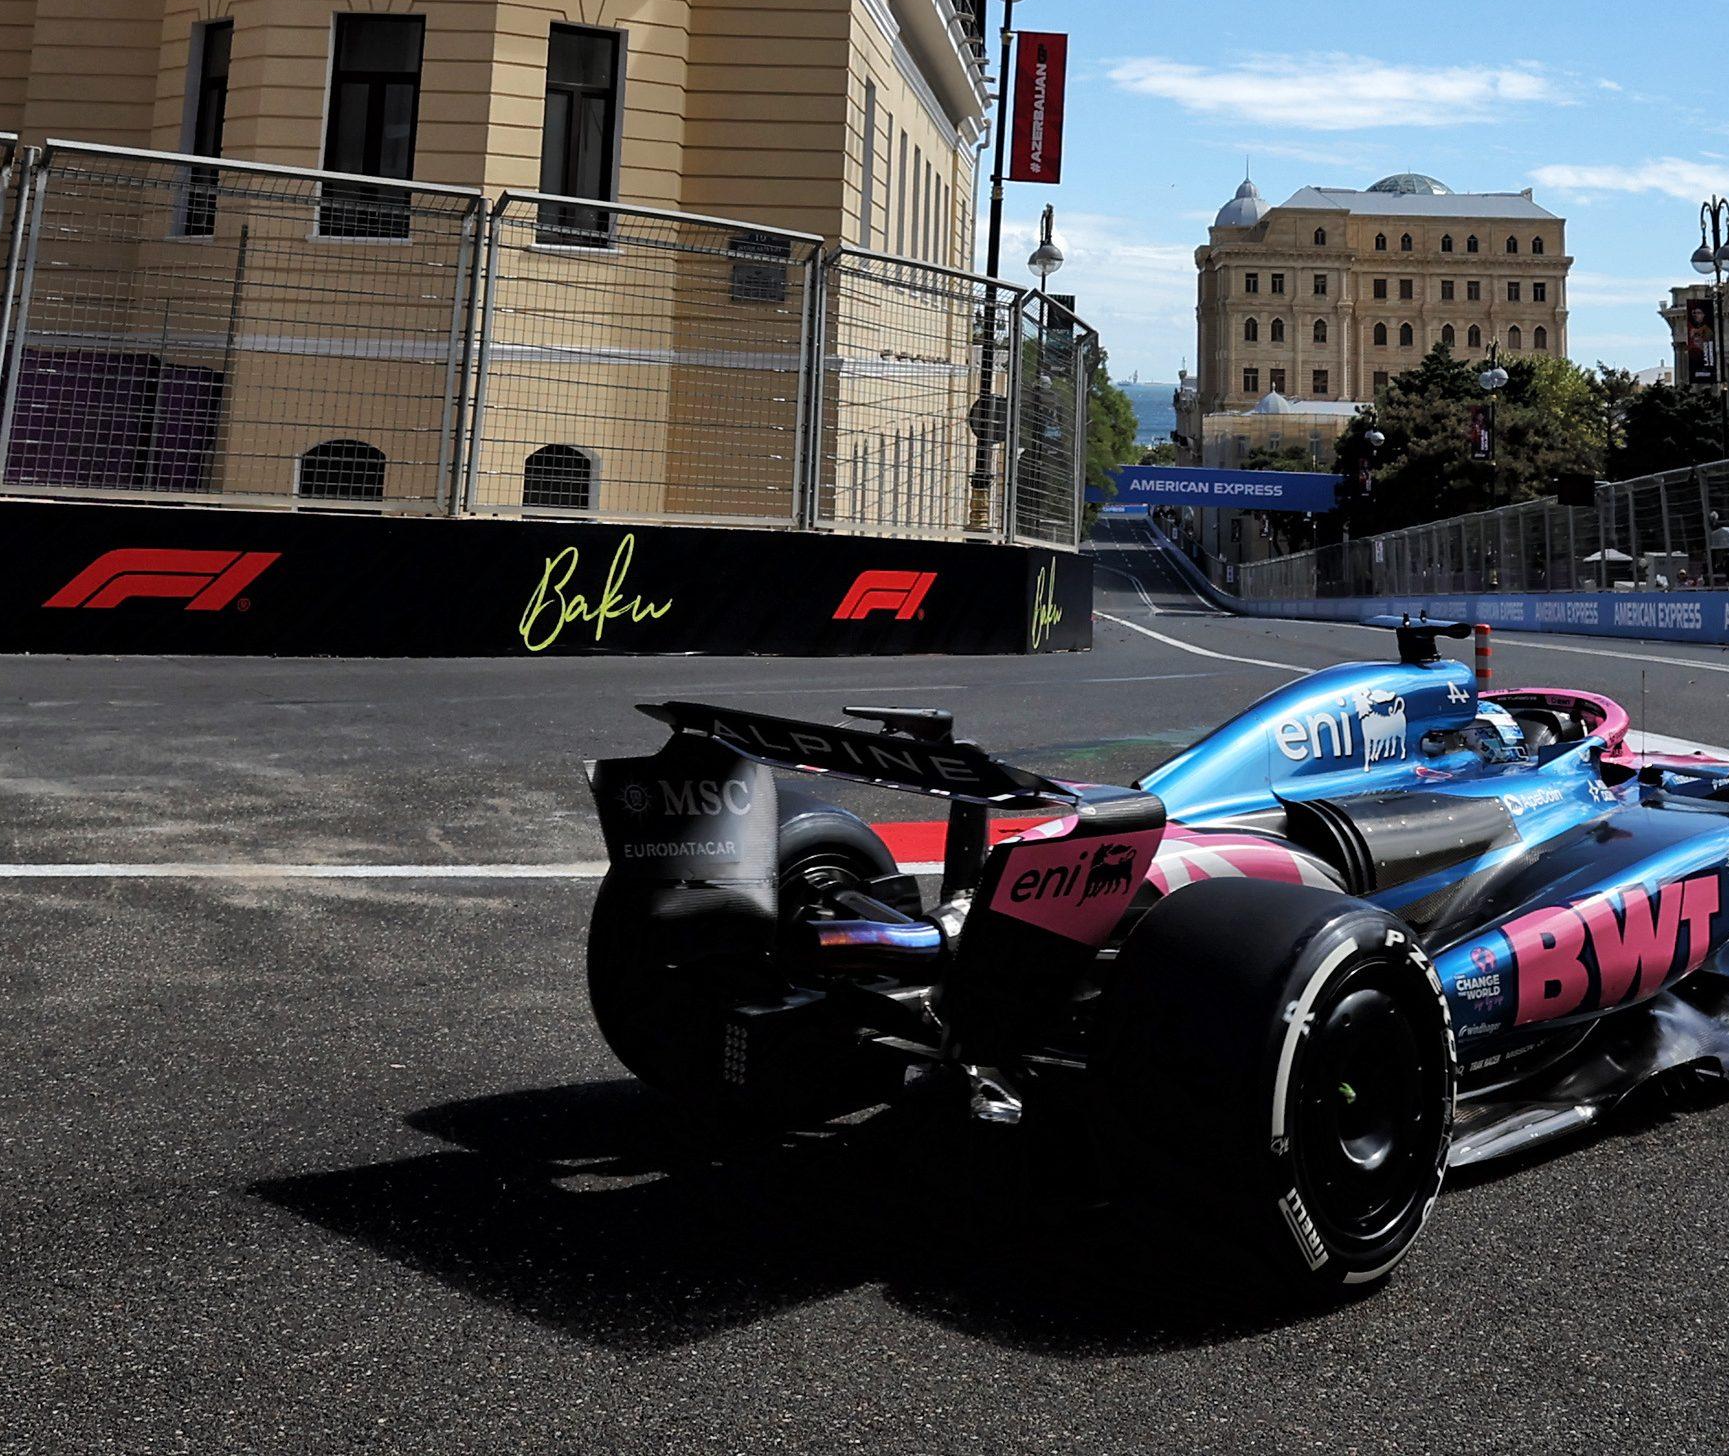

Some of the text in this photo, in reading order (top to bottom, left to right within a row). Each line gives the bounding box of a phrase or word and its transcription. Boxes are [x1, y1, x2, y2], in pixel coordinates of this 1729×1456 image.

[1130, 479, 1283, 496] AMERICAN EXPRESS
[519, 533, 673, 651] Baku
[1032, 556, 1063, 649] Baku
[1535, 601, 1598, 625] AMERICAN EXPRESS
[1614, 602, 1702, 630] AMERICAN EXPRESS
[714, 719, 980, 782] ALPINE
[1275, 697, 1352, 760] eni
[657, 779, 752, 816] MSC
[624, 841, 736, 858] EURODATACAR
[1010, 851, 1088, 903] eni
[1502, 874, 1719, 1026] BWT
[1456, 974, 1500, 991] CHANGE
[1466, 986, 1501, 1000] WORLD
[1278, 1186, 1329, 1272] PIRELLI
